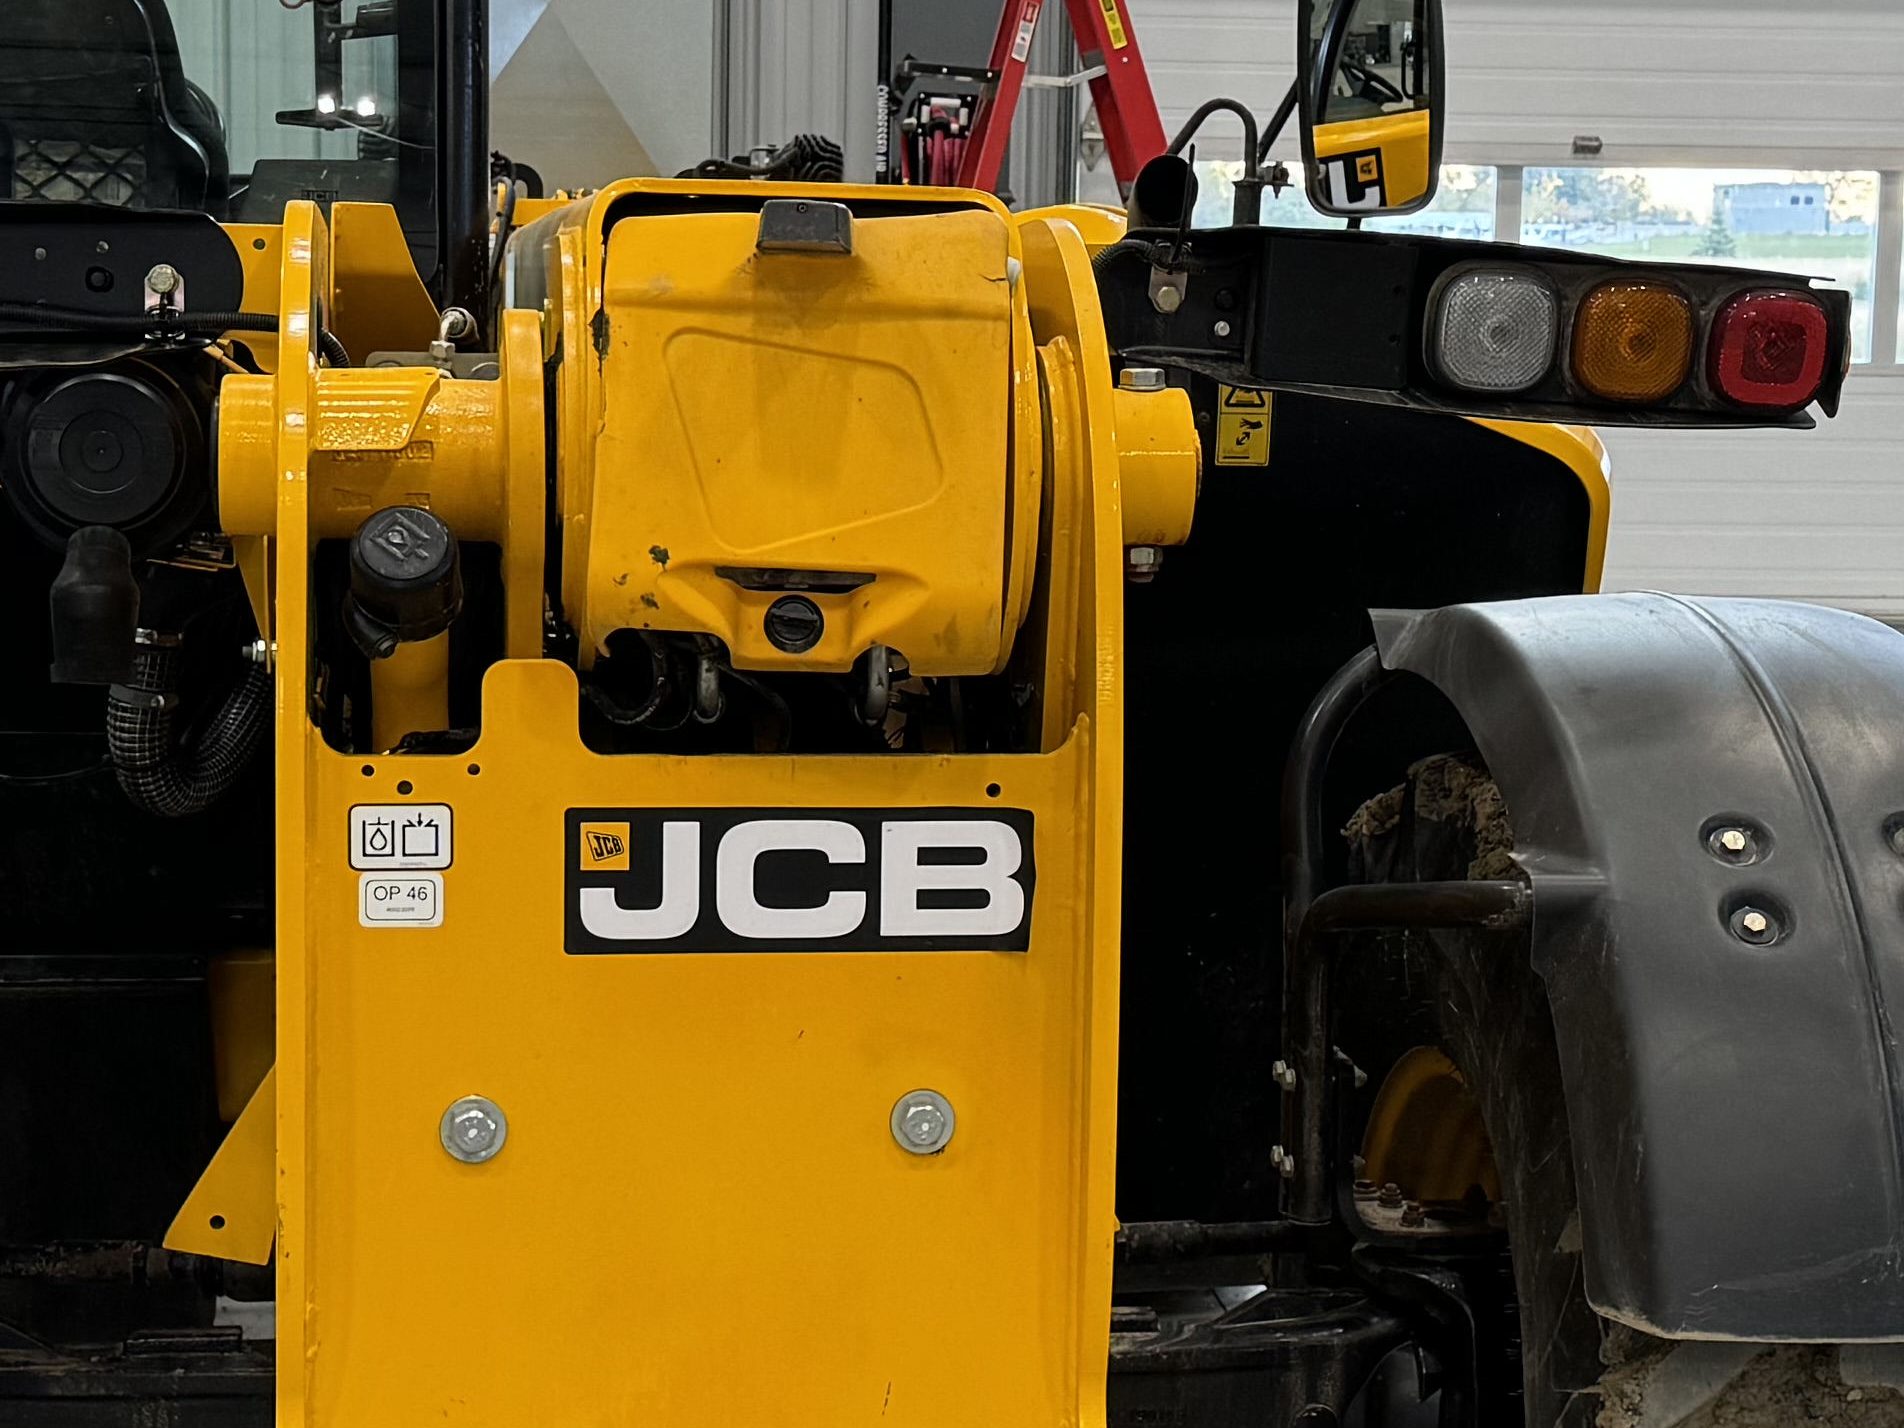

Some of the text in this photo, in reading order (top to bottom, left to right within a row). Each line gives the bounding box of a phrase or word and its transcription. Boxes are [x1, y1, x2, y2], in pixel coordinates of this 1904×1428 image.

[592, 834, 623, 859] JCB
[580, 819, 1024, 940] JCB
[373, 885, 428, 901] OP 46
